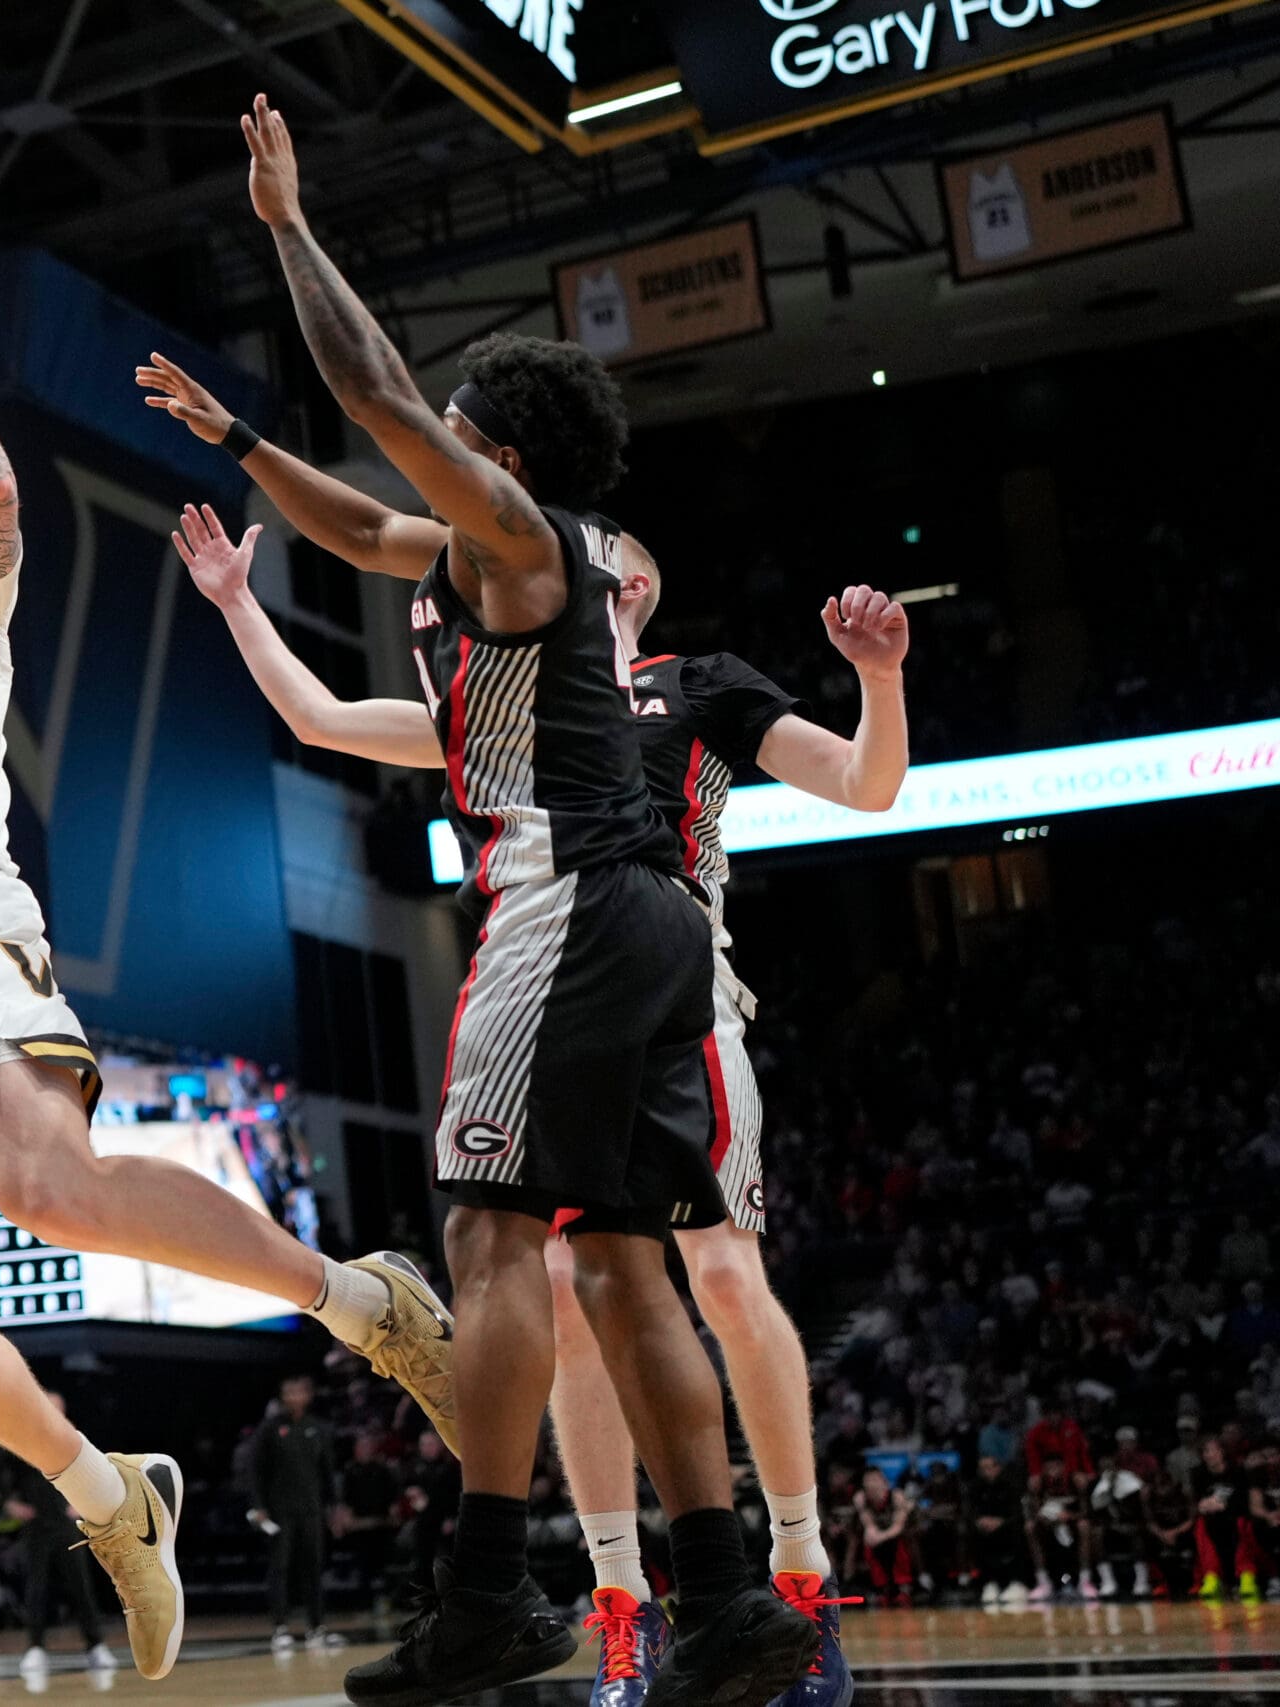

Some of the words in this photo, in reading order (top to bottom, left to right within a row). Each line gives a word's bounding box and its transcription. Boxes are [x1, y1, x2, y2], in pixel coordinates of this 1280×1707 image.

[770, 2, 936, 89] Gary
[951, 0, 1101, 41] Fo
[1032, 760, 1170, 799] CHOOSE
[451, 1118, 512, 1159] G
